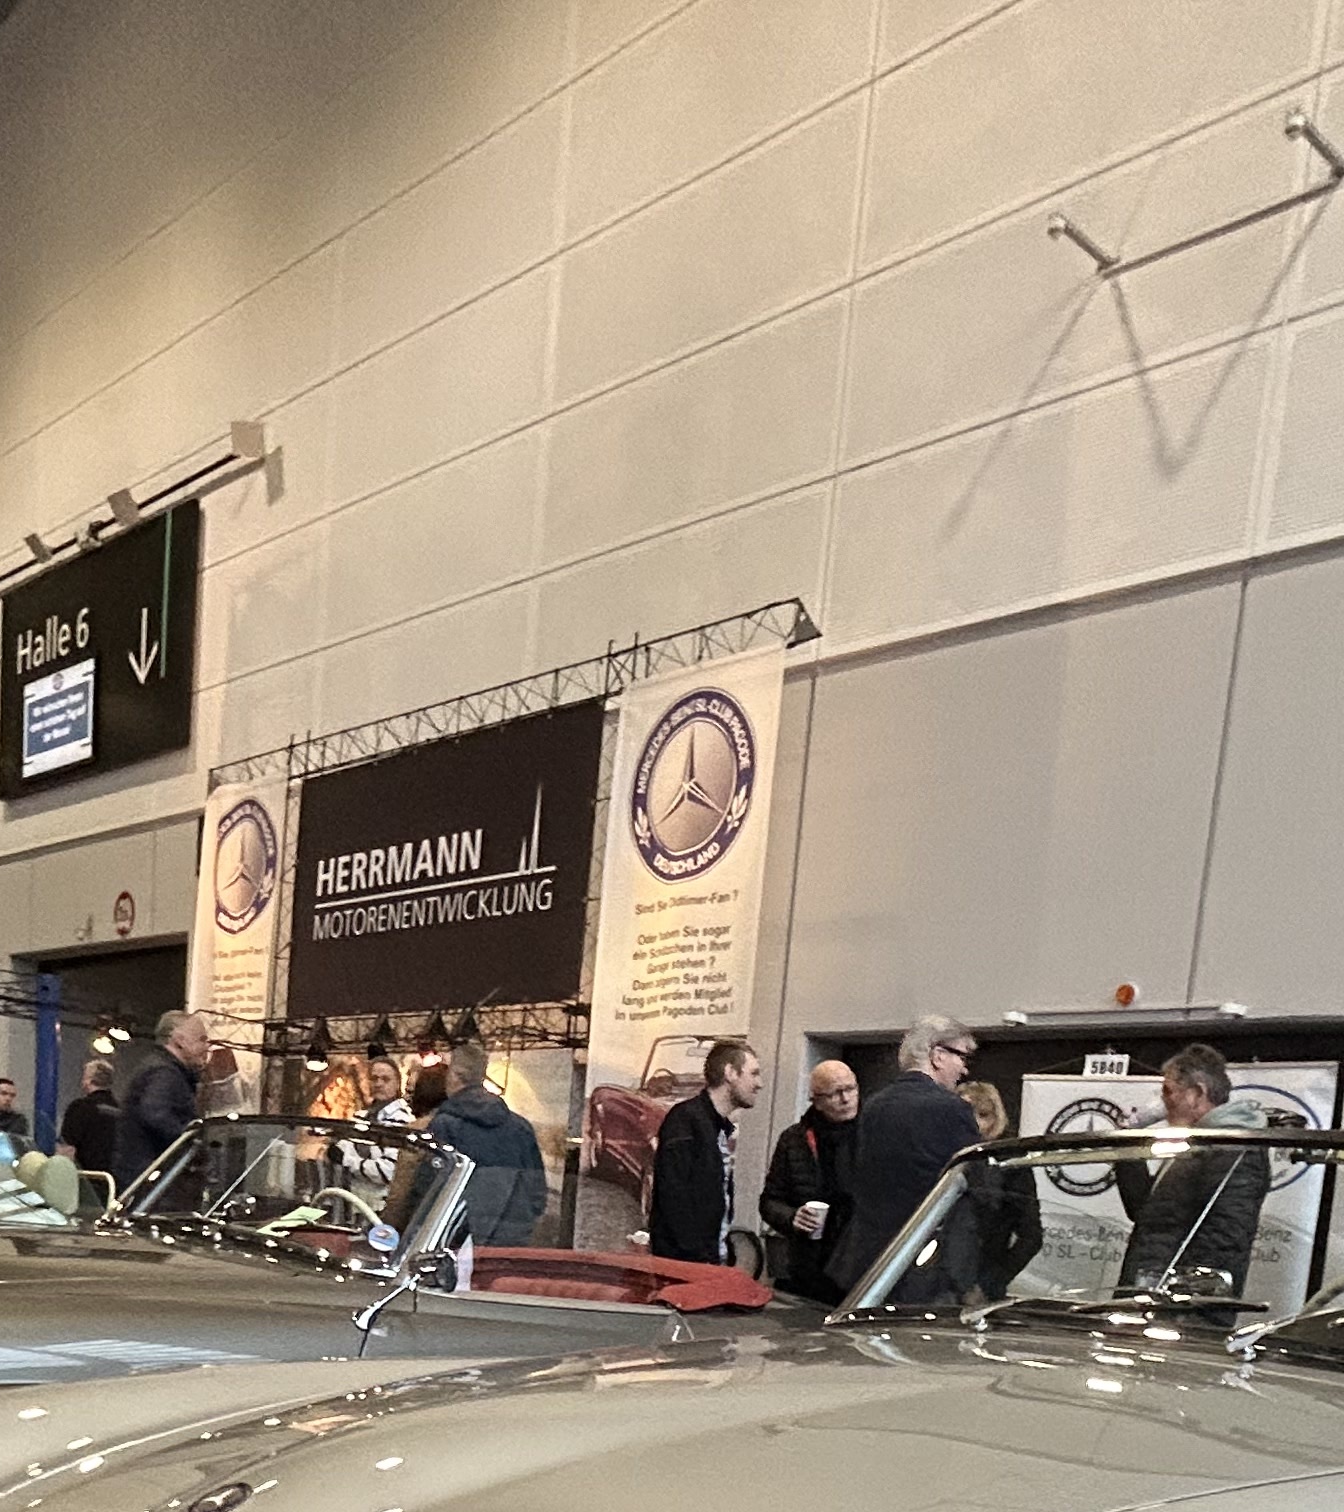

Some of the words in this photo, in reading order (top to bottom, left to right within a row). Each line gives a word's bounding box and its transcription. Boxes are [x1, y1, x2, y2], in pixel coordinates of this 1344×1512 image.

[16, 614, 72, 675] Halle
[76, 606, 90, 649] 6
[315, 828, 483, 897] HERRMANN
[312, 878, 553, 941] MOTORENENTWICKLUNG
[682, 925, 700, 938] Sie
[702, 925, 732, 939] sogar
[671, 958, 706, 969] stehen
[682, 973, 700, 985] Sie
[702, 972, 728, 983] nicht
